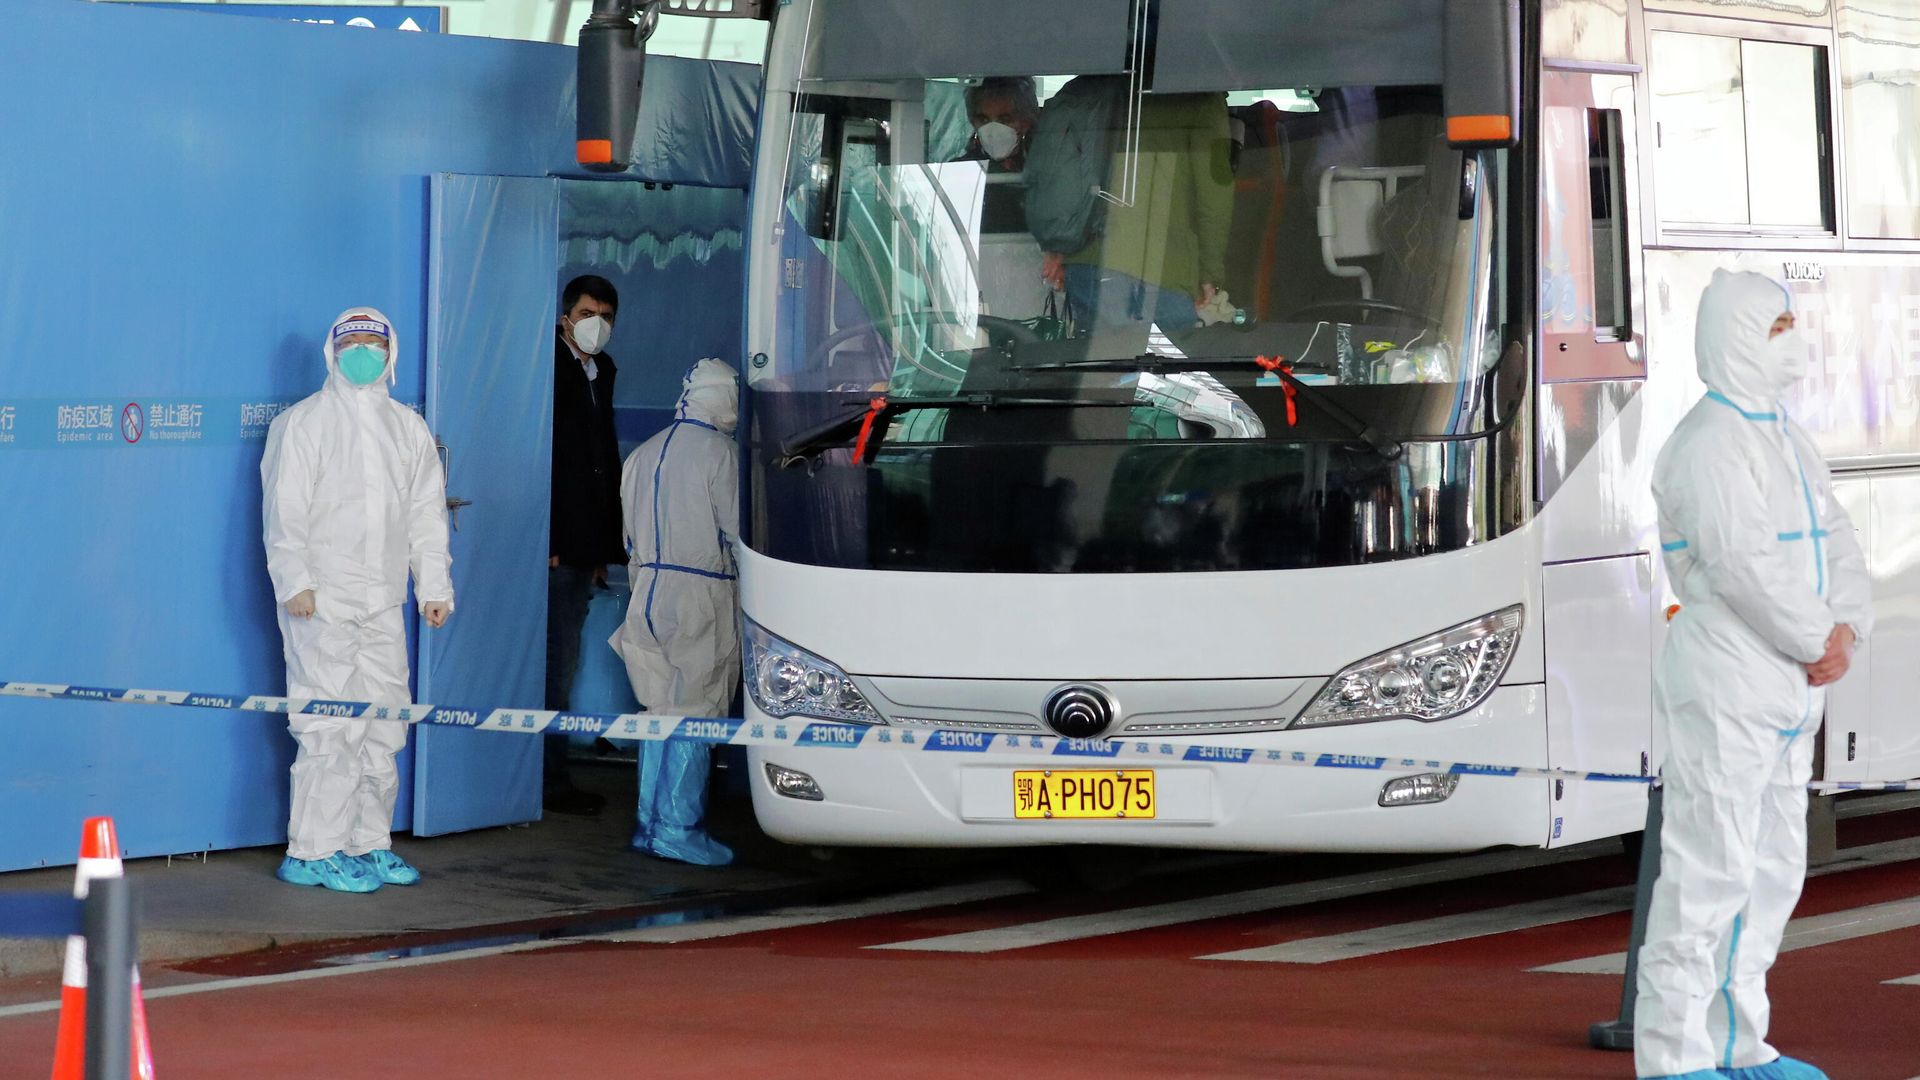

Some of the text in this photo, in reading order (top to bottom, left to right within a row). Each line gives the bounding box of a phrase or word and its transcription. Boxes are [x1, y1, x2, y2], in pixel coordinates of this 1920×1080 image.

[1783, 262, 1824, 280] YUTONG
[57, 405, 113, 429] 防疫区域
[150, 403, 203, 428] 禁止通行
[57, 431, 113, 443] Epidemic area
[150, 431, 202, 442] No thoroughfare
[312, 703, 353, 717] POLICE
[435, 709, 478, 726] POLICE
[559, 716, 602, 732] POLICE
[685, 721, 728, 737] POLICE
[812, 726, 855, 743] POLICE
[940, 731, 983, 747] POLICE
[1069, 738, 1112, 753] POLICE
